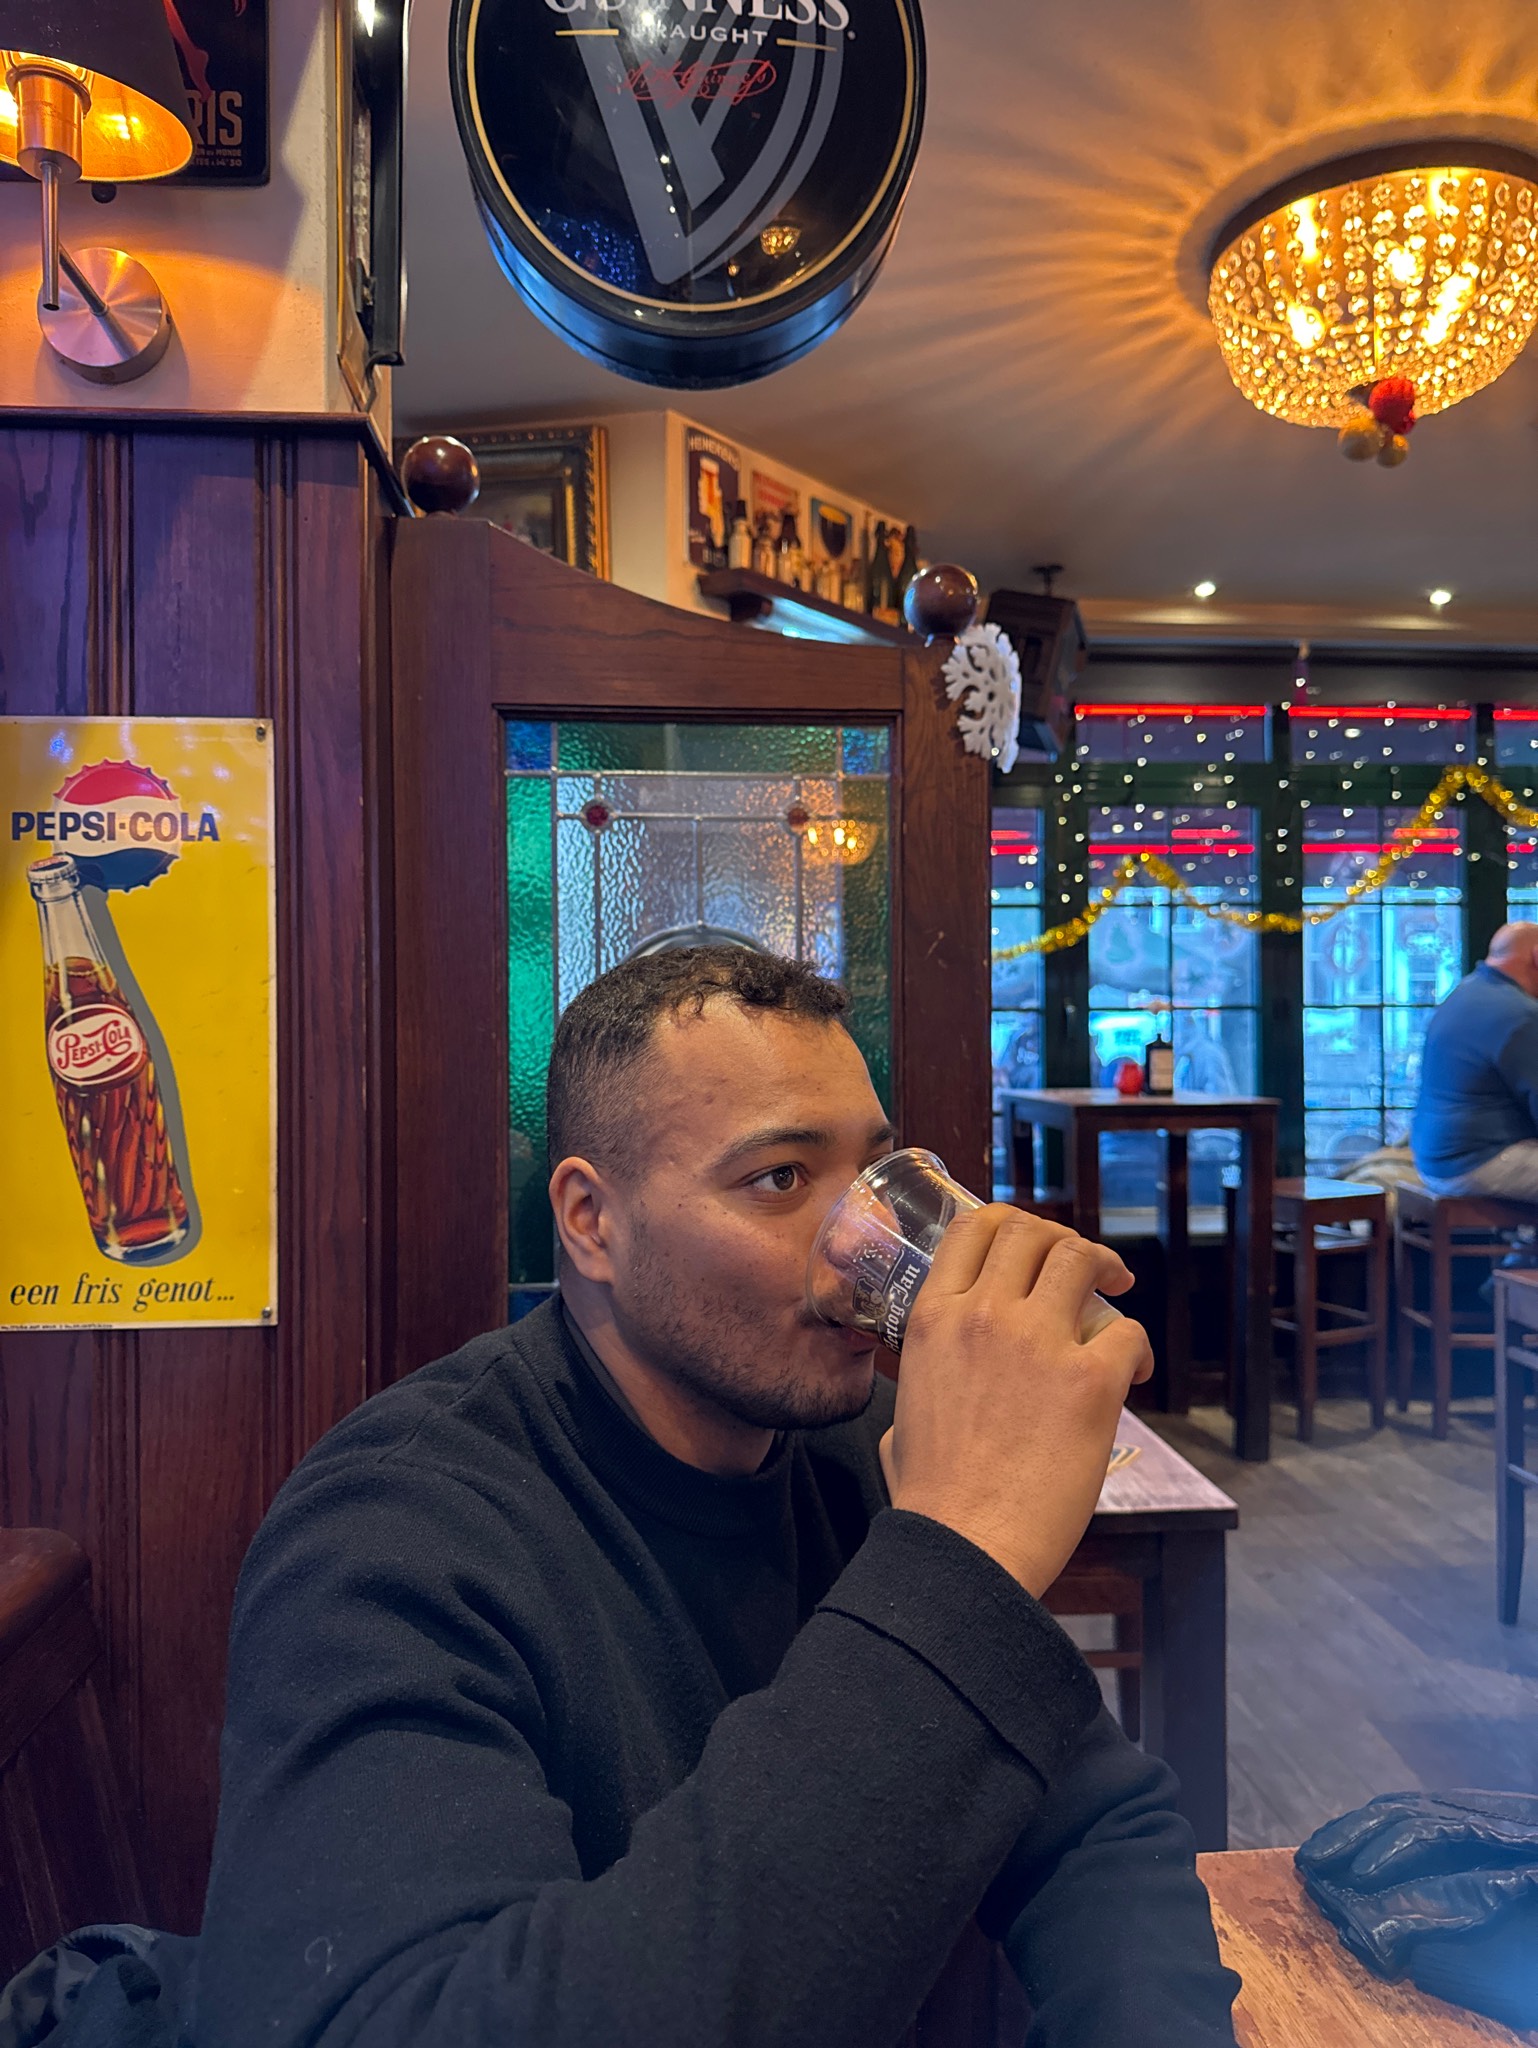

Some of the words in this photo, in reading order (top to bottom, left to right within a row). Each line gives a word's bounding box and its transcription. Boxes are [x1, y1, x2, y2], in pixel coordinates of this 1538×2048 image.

[183, 90, 242, 146] RIS
[10, 1284, 60, 1306] een
[72, 1272, 123, 1305] fris
[889, 1263, 921, 1307] Jan
